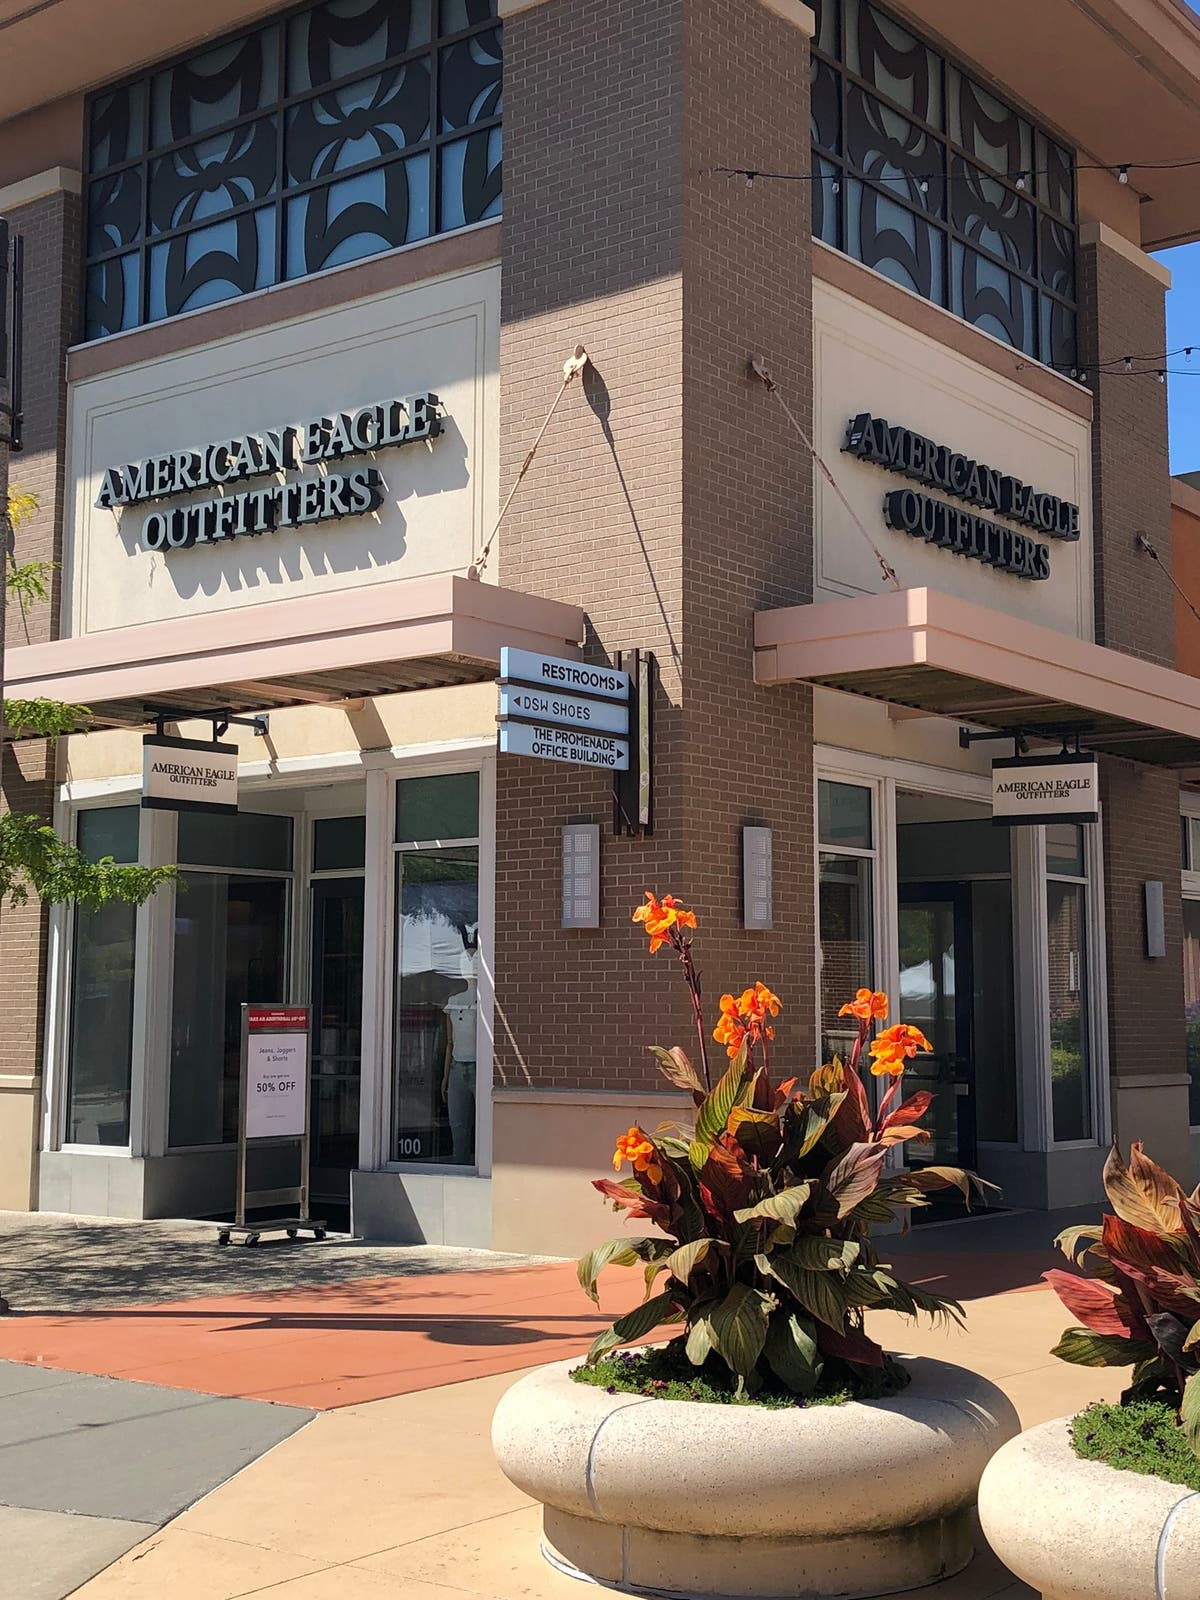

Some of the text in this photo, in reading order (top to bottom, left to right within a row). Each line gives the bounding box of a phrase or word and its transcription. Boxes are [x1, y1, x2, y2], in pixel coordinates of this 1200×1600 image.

[98, 393, 441, 507] AMERICAN EAGLE
[853, 413, 1080, 541] AMERICAN EAGLE
[141, 468, 380, 551] OUTFITTERS
[897, 489, 1051, 580] OUTFITTERS
[542, 662, 616, 691] RESTROOMS
[524, 696, 591, 720] DSW SHOES
[533, 727, 616, 752] THE PROMENADE
[532, 742, 616, 766] OFFICE BUILDING
[151, 762, 235, 781] AMERICAN EAGLE
[169, 775, 218, 787] OUTFITTERS
[996, 779, 1091, 793] AMERICAN EAGLE
[1016, 790, 1070, 800] OUTFITTERS
[256, 1081, 296, 1093] 50% OFF
[398, 1138, 421, 1155] 100
